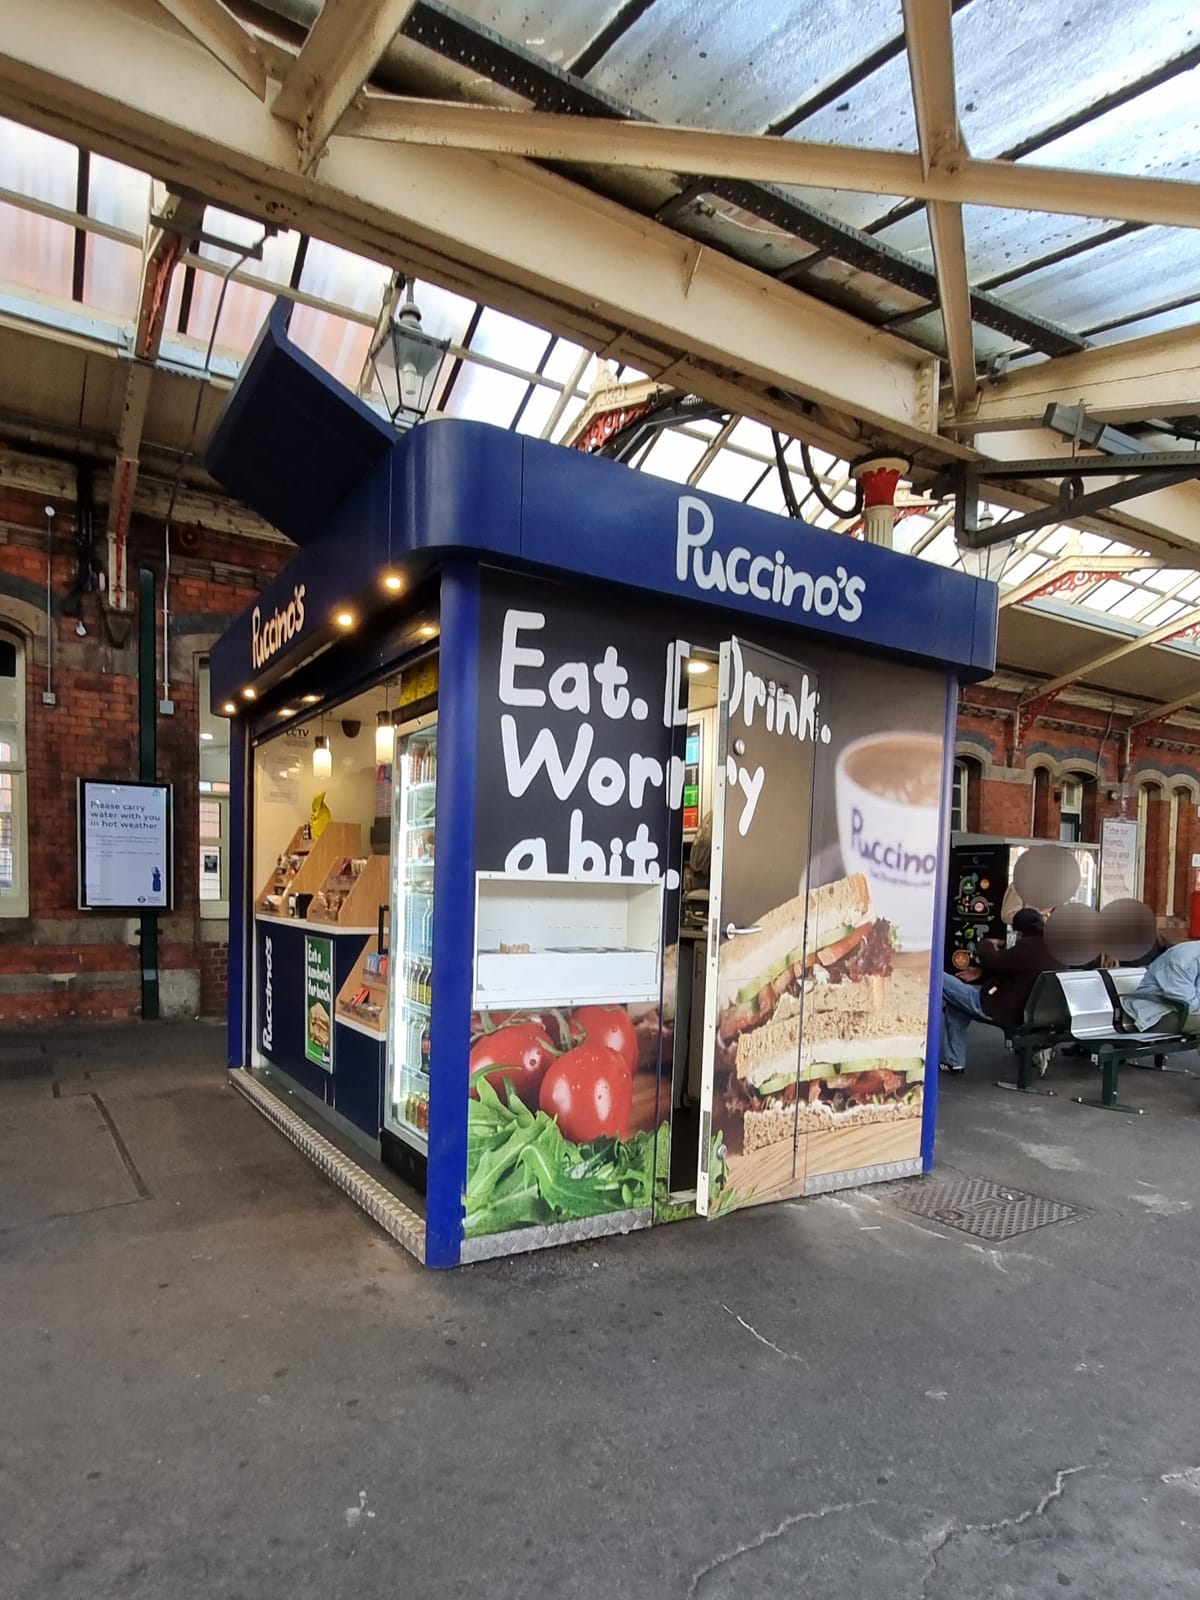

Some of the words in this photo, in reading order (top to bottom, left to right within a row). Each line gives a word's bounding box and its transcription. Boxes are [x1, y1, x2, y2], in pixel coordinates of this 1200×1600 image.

[676, 495, 867, 623] Puccino's
[251, 583, 306, 670] Puccino's
[498, 608, 649, 721] Eat.
[90, 801, 120, 810] Please
[122, 803, 146, 812] carry
[90, 811, 117, 819] water
[120, 811, 142, 820] with
[143, 814, 161, 822] you
[500, 713, 765, 837] Worry
[102, 820, 118, 828] hot
[120, 821, 158, 830] weather
[504, 836, 548, 875] a
[568, 808, 680, 891] bit.
[262, 935, 273, 1052] Puccino's
